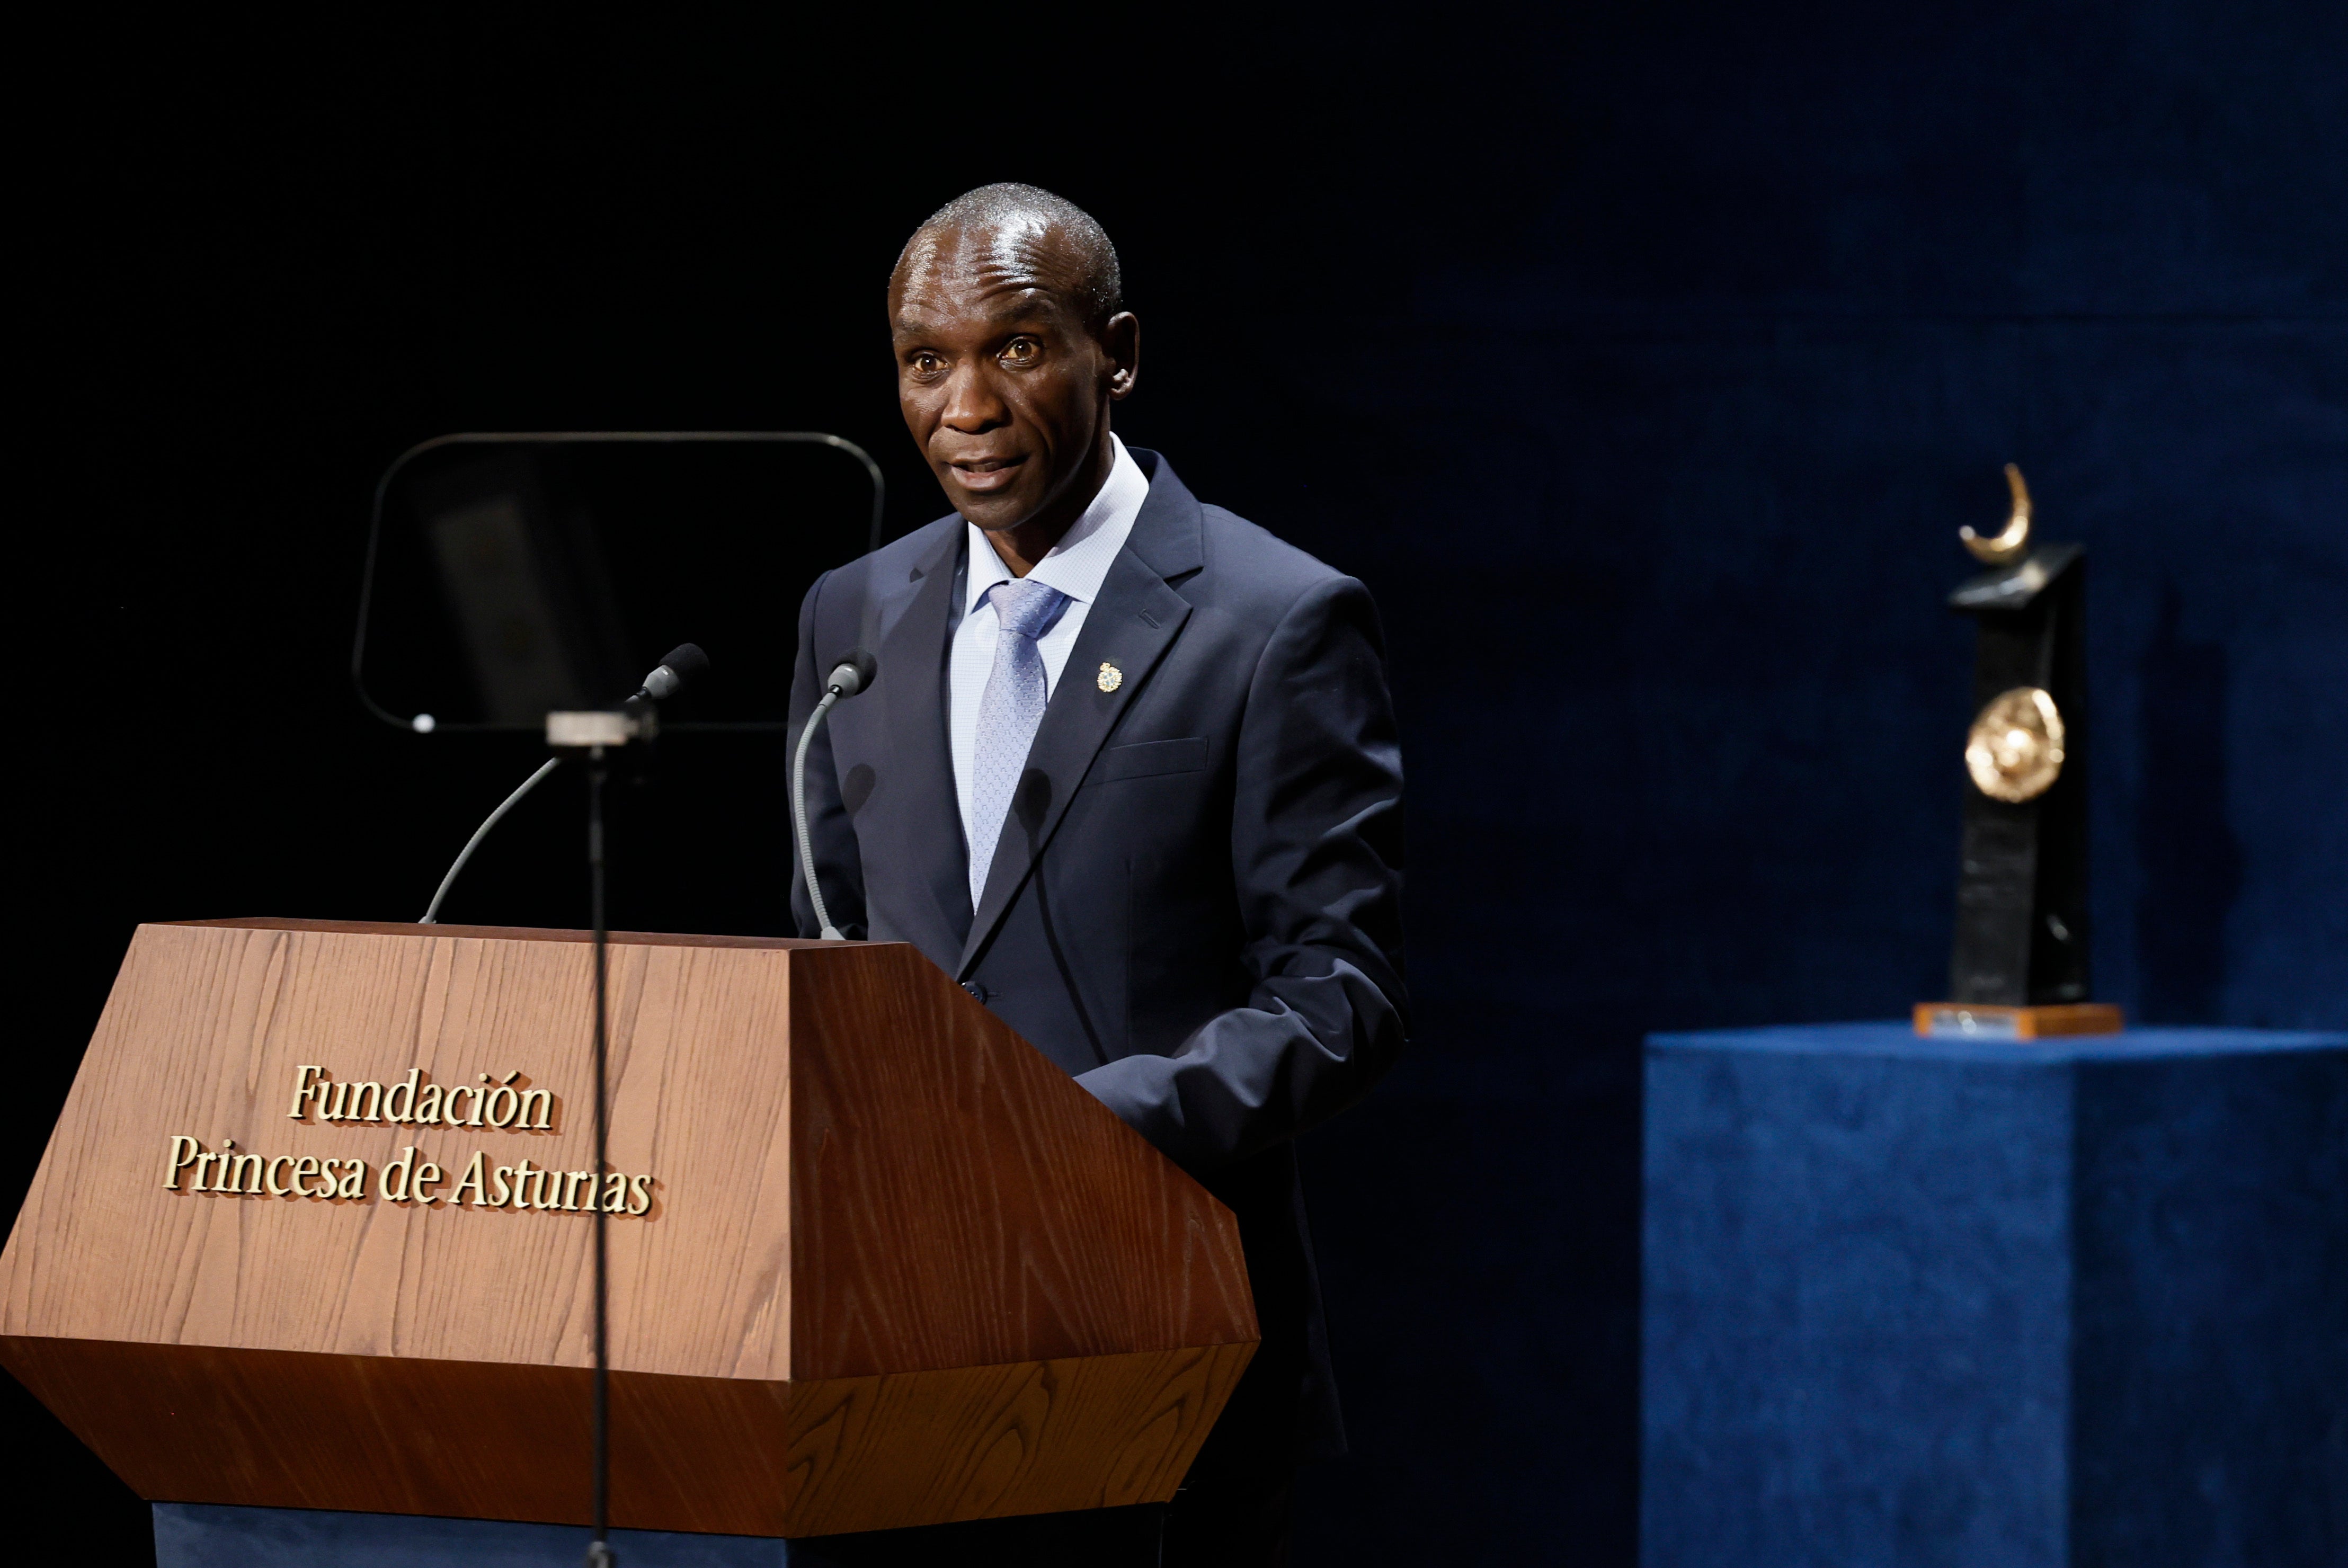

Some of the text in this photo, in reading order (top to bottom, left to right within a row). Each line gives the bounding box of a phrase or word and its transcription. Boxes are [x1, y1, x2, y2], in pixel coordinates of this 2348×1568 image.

[287, 1064, 552, 1129] Fundación
[162, 1135, 652, 1215] Princesa de Asturias
